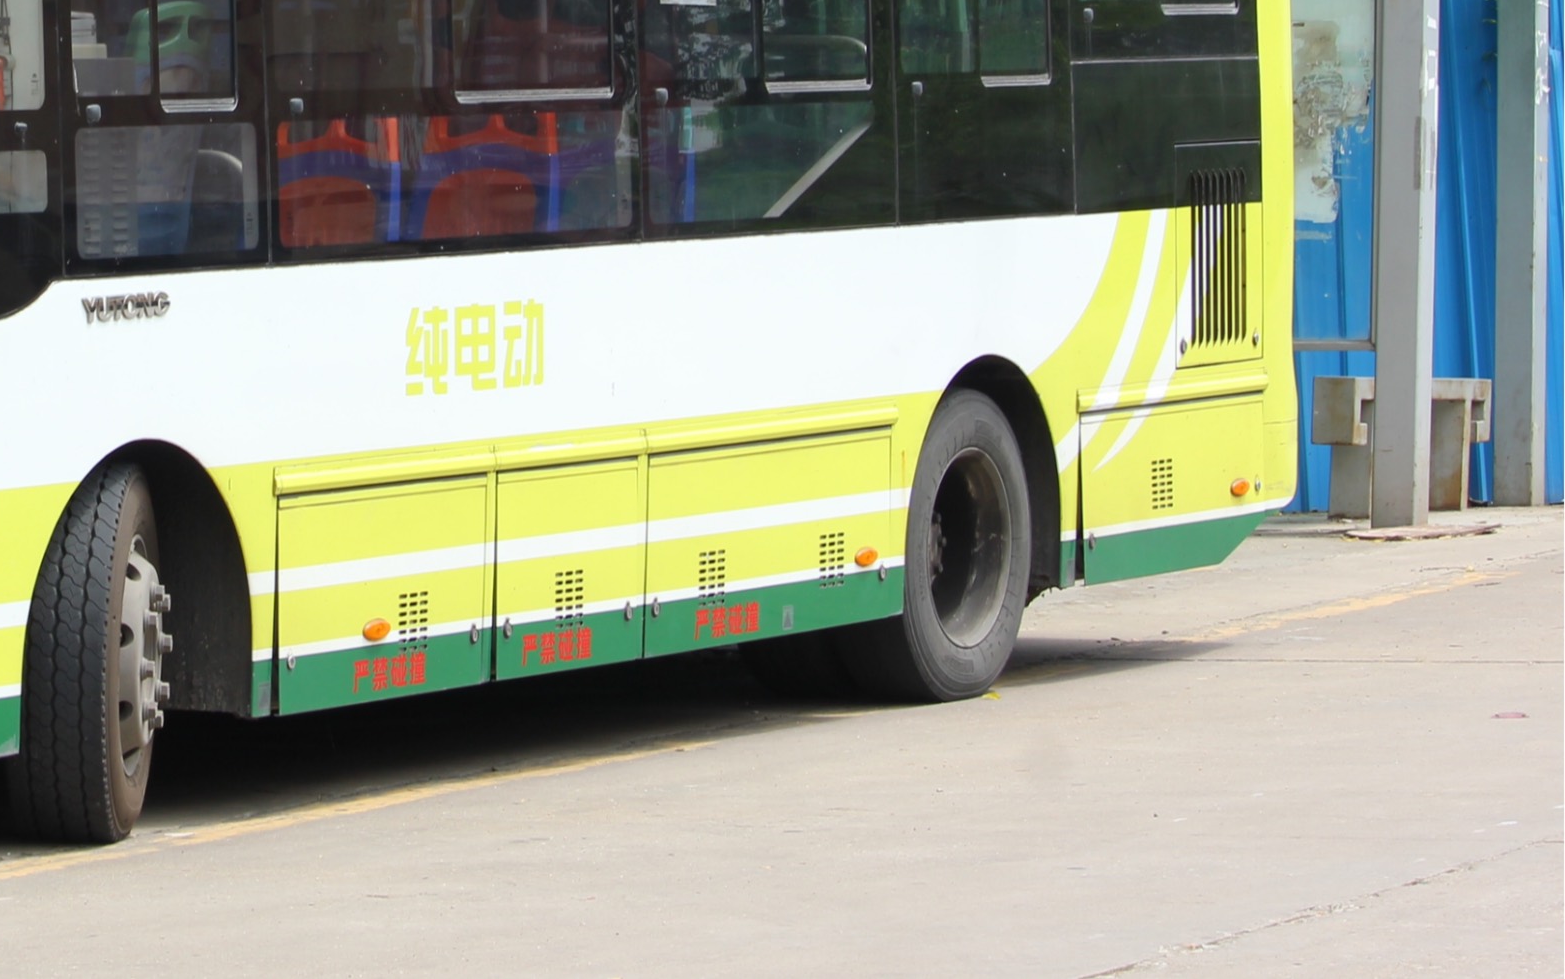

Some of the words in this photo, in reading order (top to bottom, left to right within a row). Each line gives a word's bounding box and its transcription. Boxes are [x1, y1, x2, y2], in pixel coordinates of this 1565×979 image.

[81, 290, 171, 325] YUTONG
[406, 299, 544, 397] 纯电动
[694, 601, 760, 641] 严禁碰撞
[521, 626, 593, 667] 严禁碰撞
[353, 651, 427, 694] 严禁碰撞
